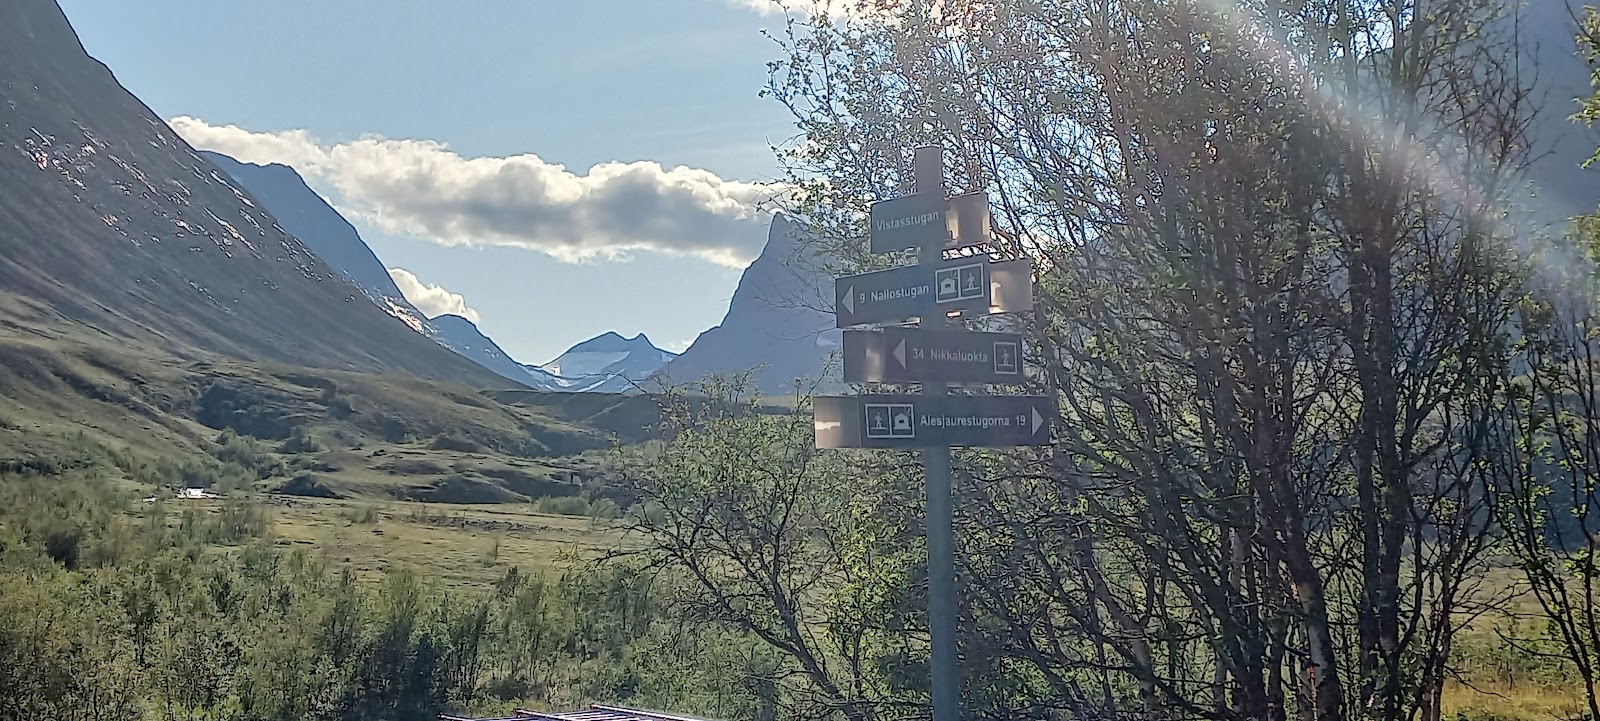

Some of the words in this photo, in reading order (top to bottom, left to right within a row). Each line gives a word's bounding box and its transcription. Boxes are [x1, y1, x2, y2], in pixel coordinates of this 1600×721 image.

[876, 211, 939, 231] Vistasstugan
[859, 291, 866, 304] 9
[870, 285, 929, 302] Nallostugan
[913, 348, 925, 360] 34
[930, 348, 988, 363] Nikkaluokta
[920, 414, 1010, 429] Alesjaurestugorna
[1015, 414, 1026, 426] 19
